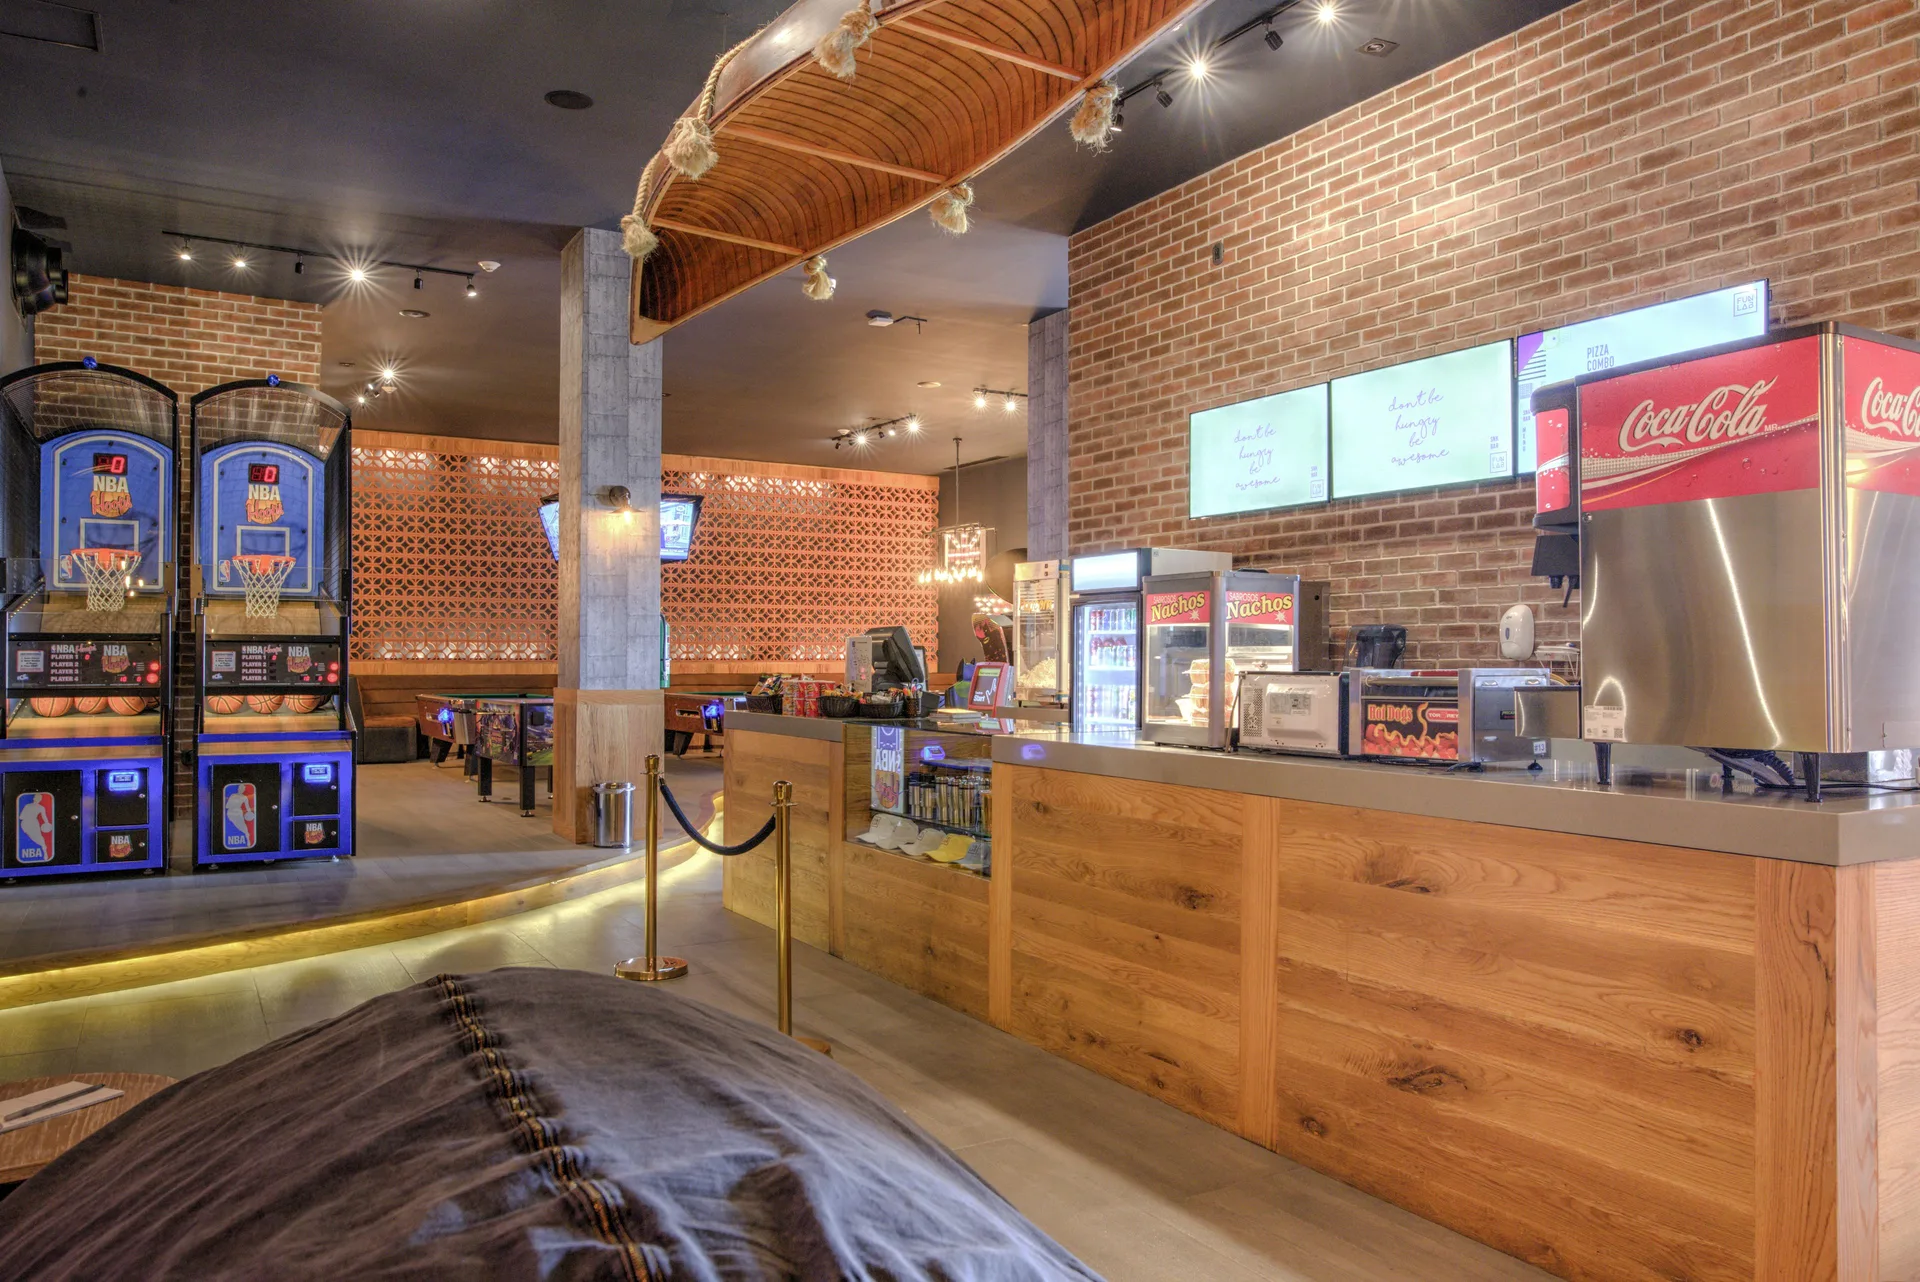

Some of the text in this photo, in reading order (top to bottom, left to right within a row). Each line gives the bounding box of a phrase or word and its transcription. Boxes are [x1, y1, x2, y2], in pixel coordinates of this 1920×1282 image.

[1736, 295, 1754, 304] FUN
[1736, 302, 1754, 312] LAB
[1587, 344, 1610, 359] PIZZA
[1587, 356, 1614, 371] COMBO
[1428, 388, 1444, 404] be
[1618, 376, 1779, 452] Coca-Cola
[1264, 423, 1277, 436] be
[1395, 414, 1441, 439] hungry
[1408, 432, 1424, 448] be
[1238, 446, 1274, 467] hungry
[1391, 449, 1450, 466] awesome
[1249, 461, 1261, 474] be
[93, 476, 130, 492] NBA
[1235, 476, 1281, 490] awesome
[248, 484, 281, 500] NBA
[90, 491, 132, 515] Hoops
[245, 500, 284, 522] Hoops
[1151, 592, 1206, 622] Nachos
[1226, 594, 1293, 620] Nachos
[56, 645, 74, 654] NBA
[103, 645, 128, 656] NBA
[246, 646, 264, 654] NBA
[288, 646, 310, 656] NBA
[1368, 704, 1413, 725] Hot Dogs
[1534, 744, 1545, 752] #13
[306, 823, 322, 831] NBA
[111, 835, 130, 845] NBA
[228, 836, 246, 844] NBA
[22, 848, 42, 858] NBA
